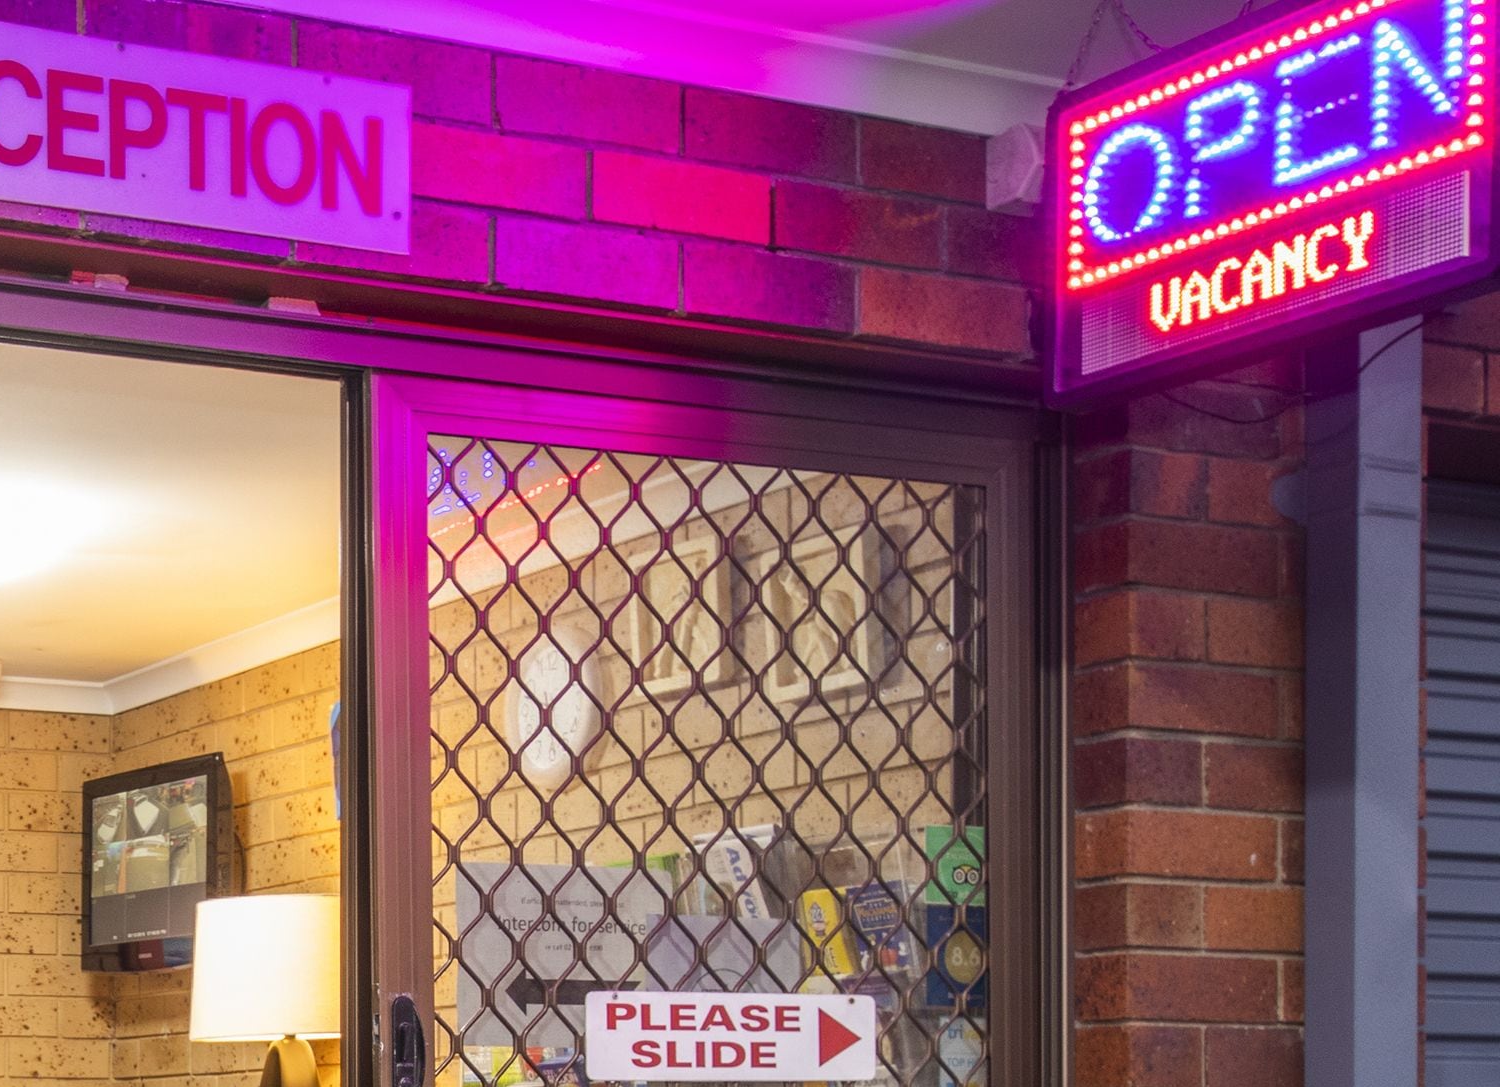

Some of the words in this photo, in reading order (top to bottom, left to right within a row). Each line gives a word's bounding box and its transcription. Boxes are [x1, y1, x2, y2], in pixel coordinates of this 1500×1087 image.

[1085, 0, 1468, 243] OPEN
[1150, 210, 1375, 331] VACANCY
[572, 916, 593, 932] for
[598, 920, 646, 935] serice
[952, 946, 980, 967] 8.6
[606, 1003, 801, 1032] PLEASE
[631, 1040, 777, 1069] SLIDE
